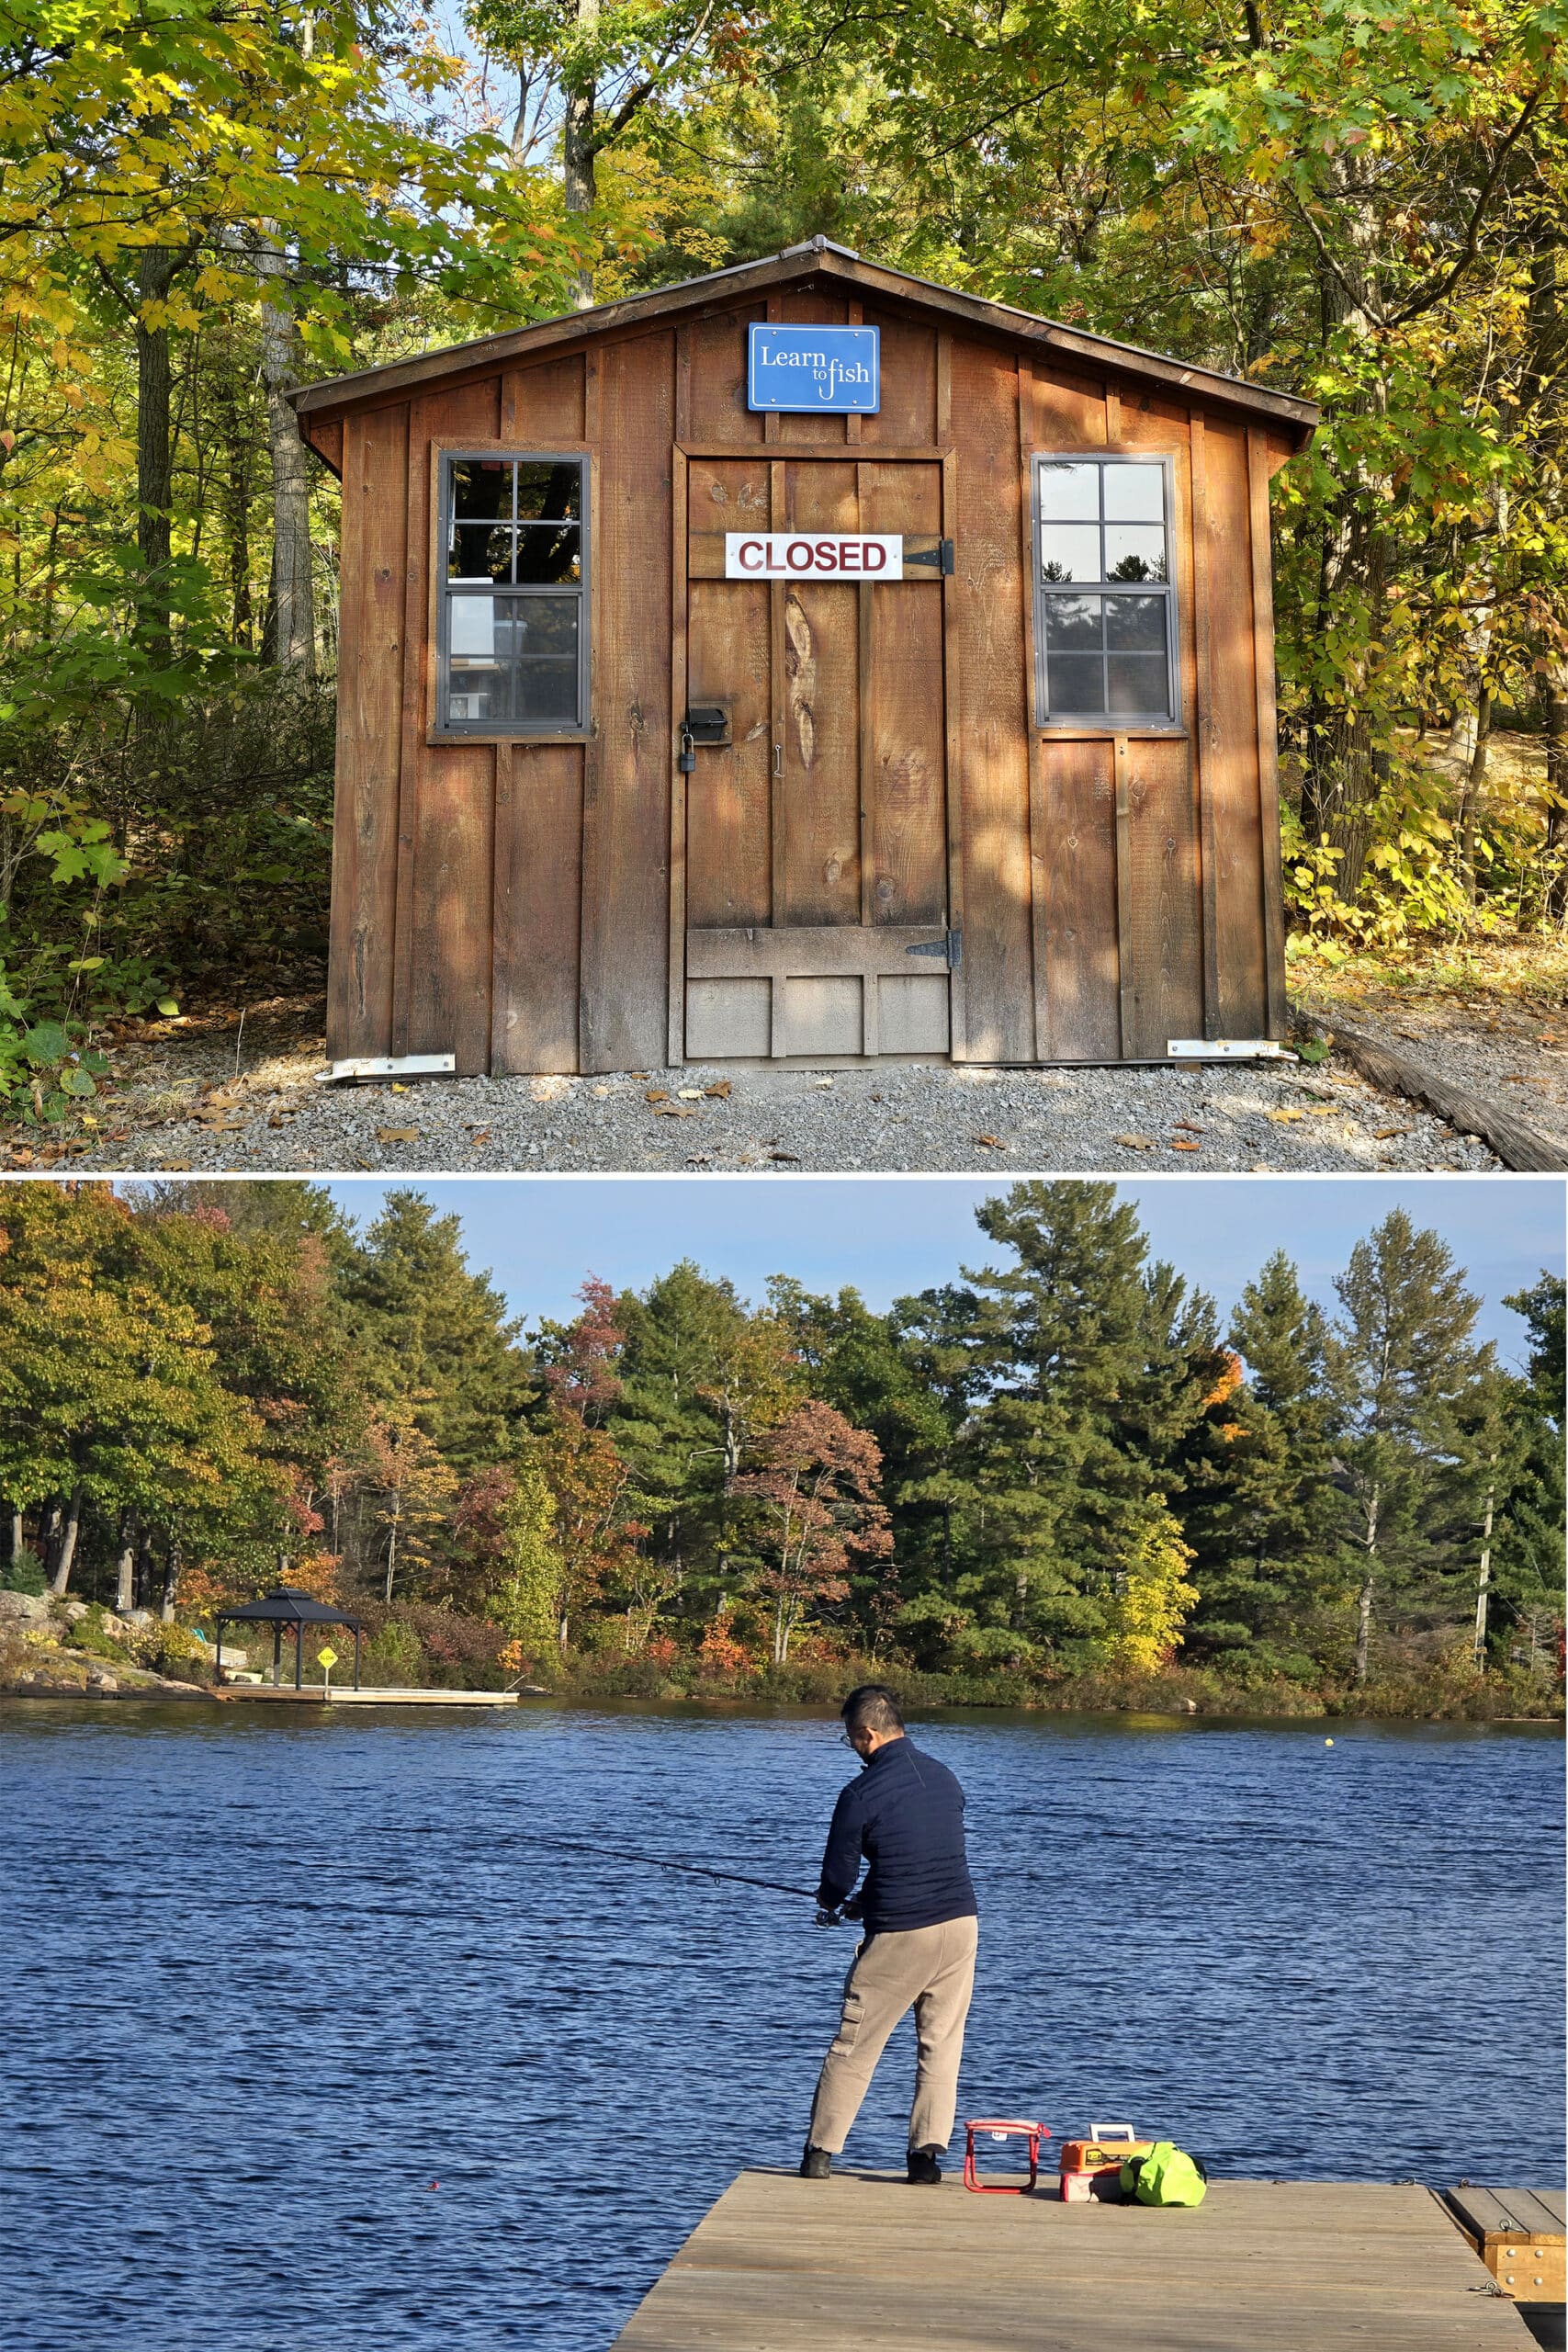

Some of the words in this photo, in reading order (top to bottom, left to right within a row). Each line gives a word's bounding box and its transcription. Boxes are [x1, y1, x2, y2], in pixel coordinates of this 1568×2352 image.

[761, 345, 827, 368] Learn
[813, 368, 827, 380] to
[818, 358, 870, 401] fish
[739, 541, 886, 571] CLOSED
